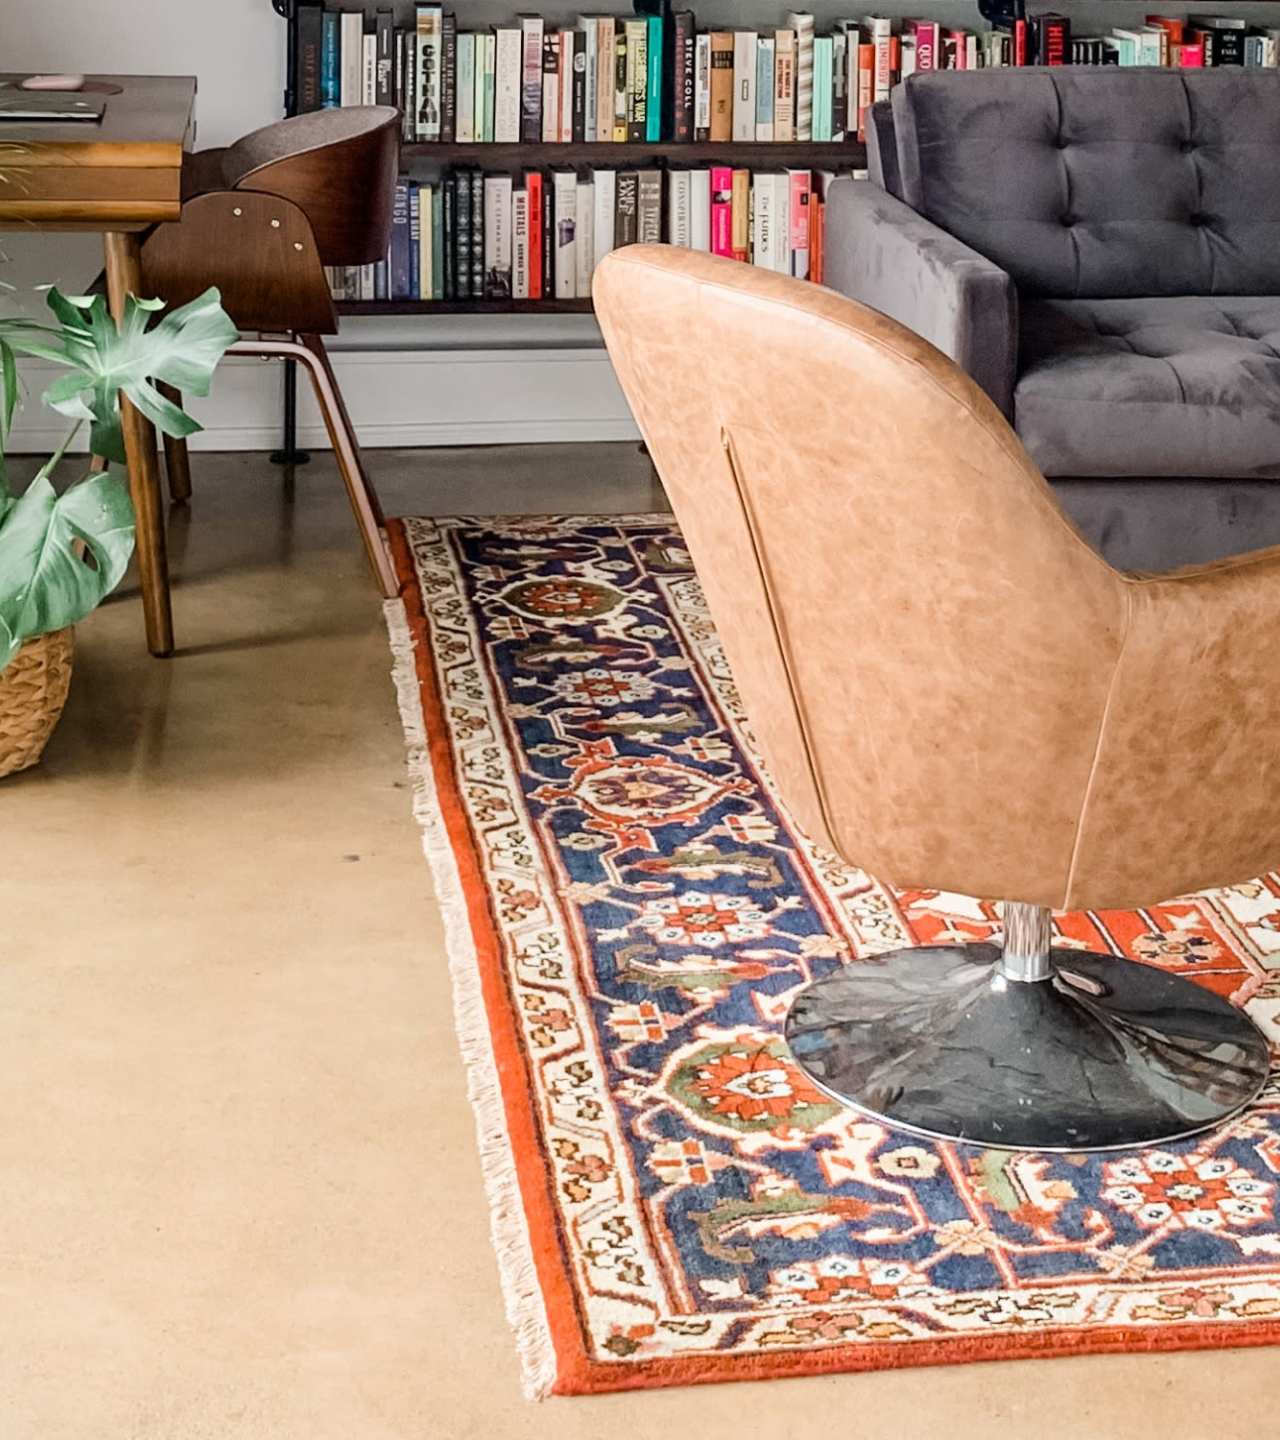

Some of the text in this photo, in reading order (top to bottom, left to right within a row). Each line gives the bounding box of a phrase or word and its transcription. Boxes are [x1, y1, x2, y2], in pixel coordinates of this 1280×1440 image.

[685, 39, 693, 109] STEVE COLL
[633, 102, 646, 122] WAR
[393, 185, 407, 224] CONGO
[618, 179, 628, 213] JOYCE
[626, 179, 635, 215] JAMES
[516, 197, 525, 236] MORTALS
